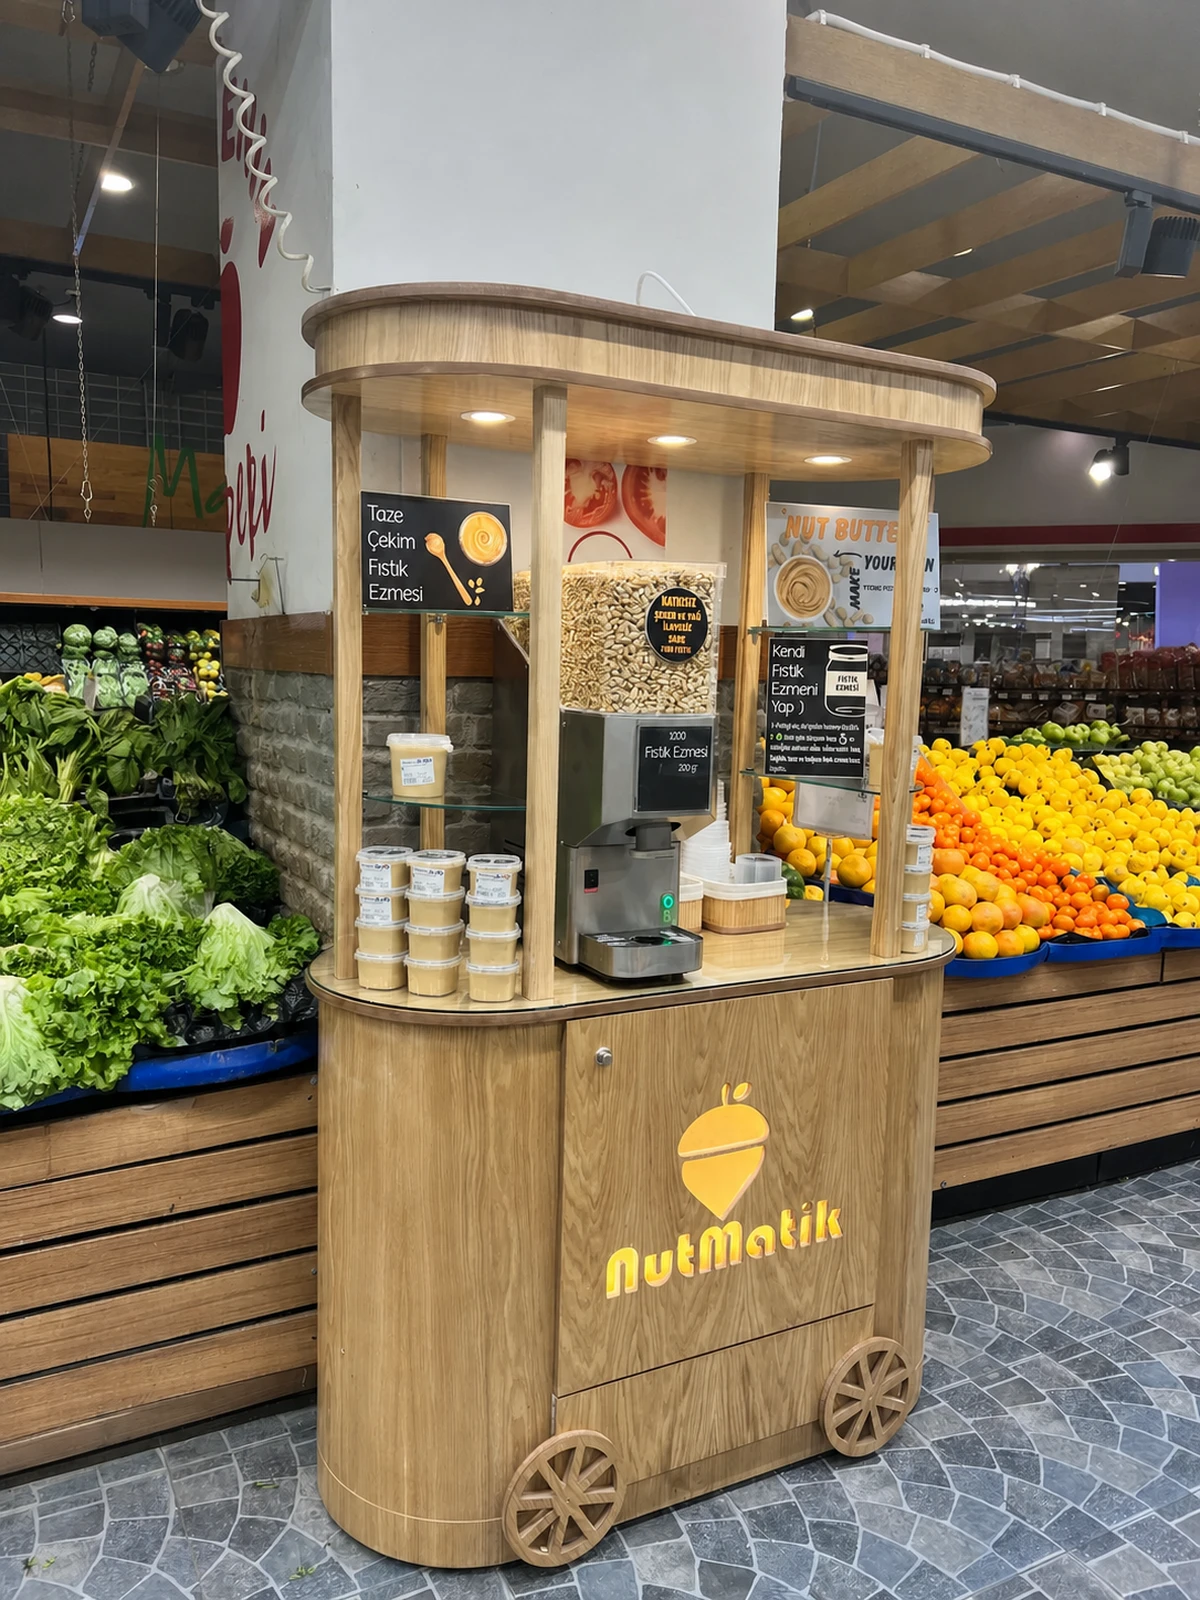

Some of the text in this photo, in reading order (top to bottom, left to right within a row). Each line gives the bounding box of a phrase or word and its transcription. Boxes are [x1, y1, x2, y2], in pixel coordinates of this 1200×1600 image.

[367, 504, 404, 523] Taze
[784, 515, 899, 543] NUT BUTTE
[367, 530, 416, 552] Çekim
[368, 558, 409, 577] Fıstık
[369, 584, 423, 602] Ezmesi
[849, 567, 860, 610] MAKE
[772, 644, 805, 658] Kendi
[772, 664, 804, 678] Fıstık
[771, 682, 818, 696] Ezmeni
[771, 700, 794, 717] Yap
[673, 745, 708, 758] Ezmesi
